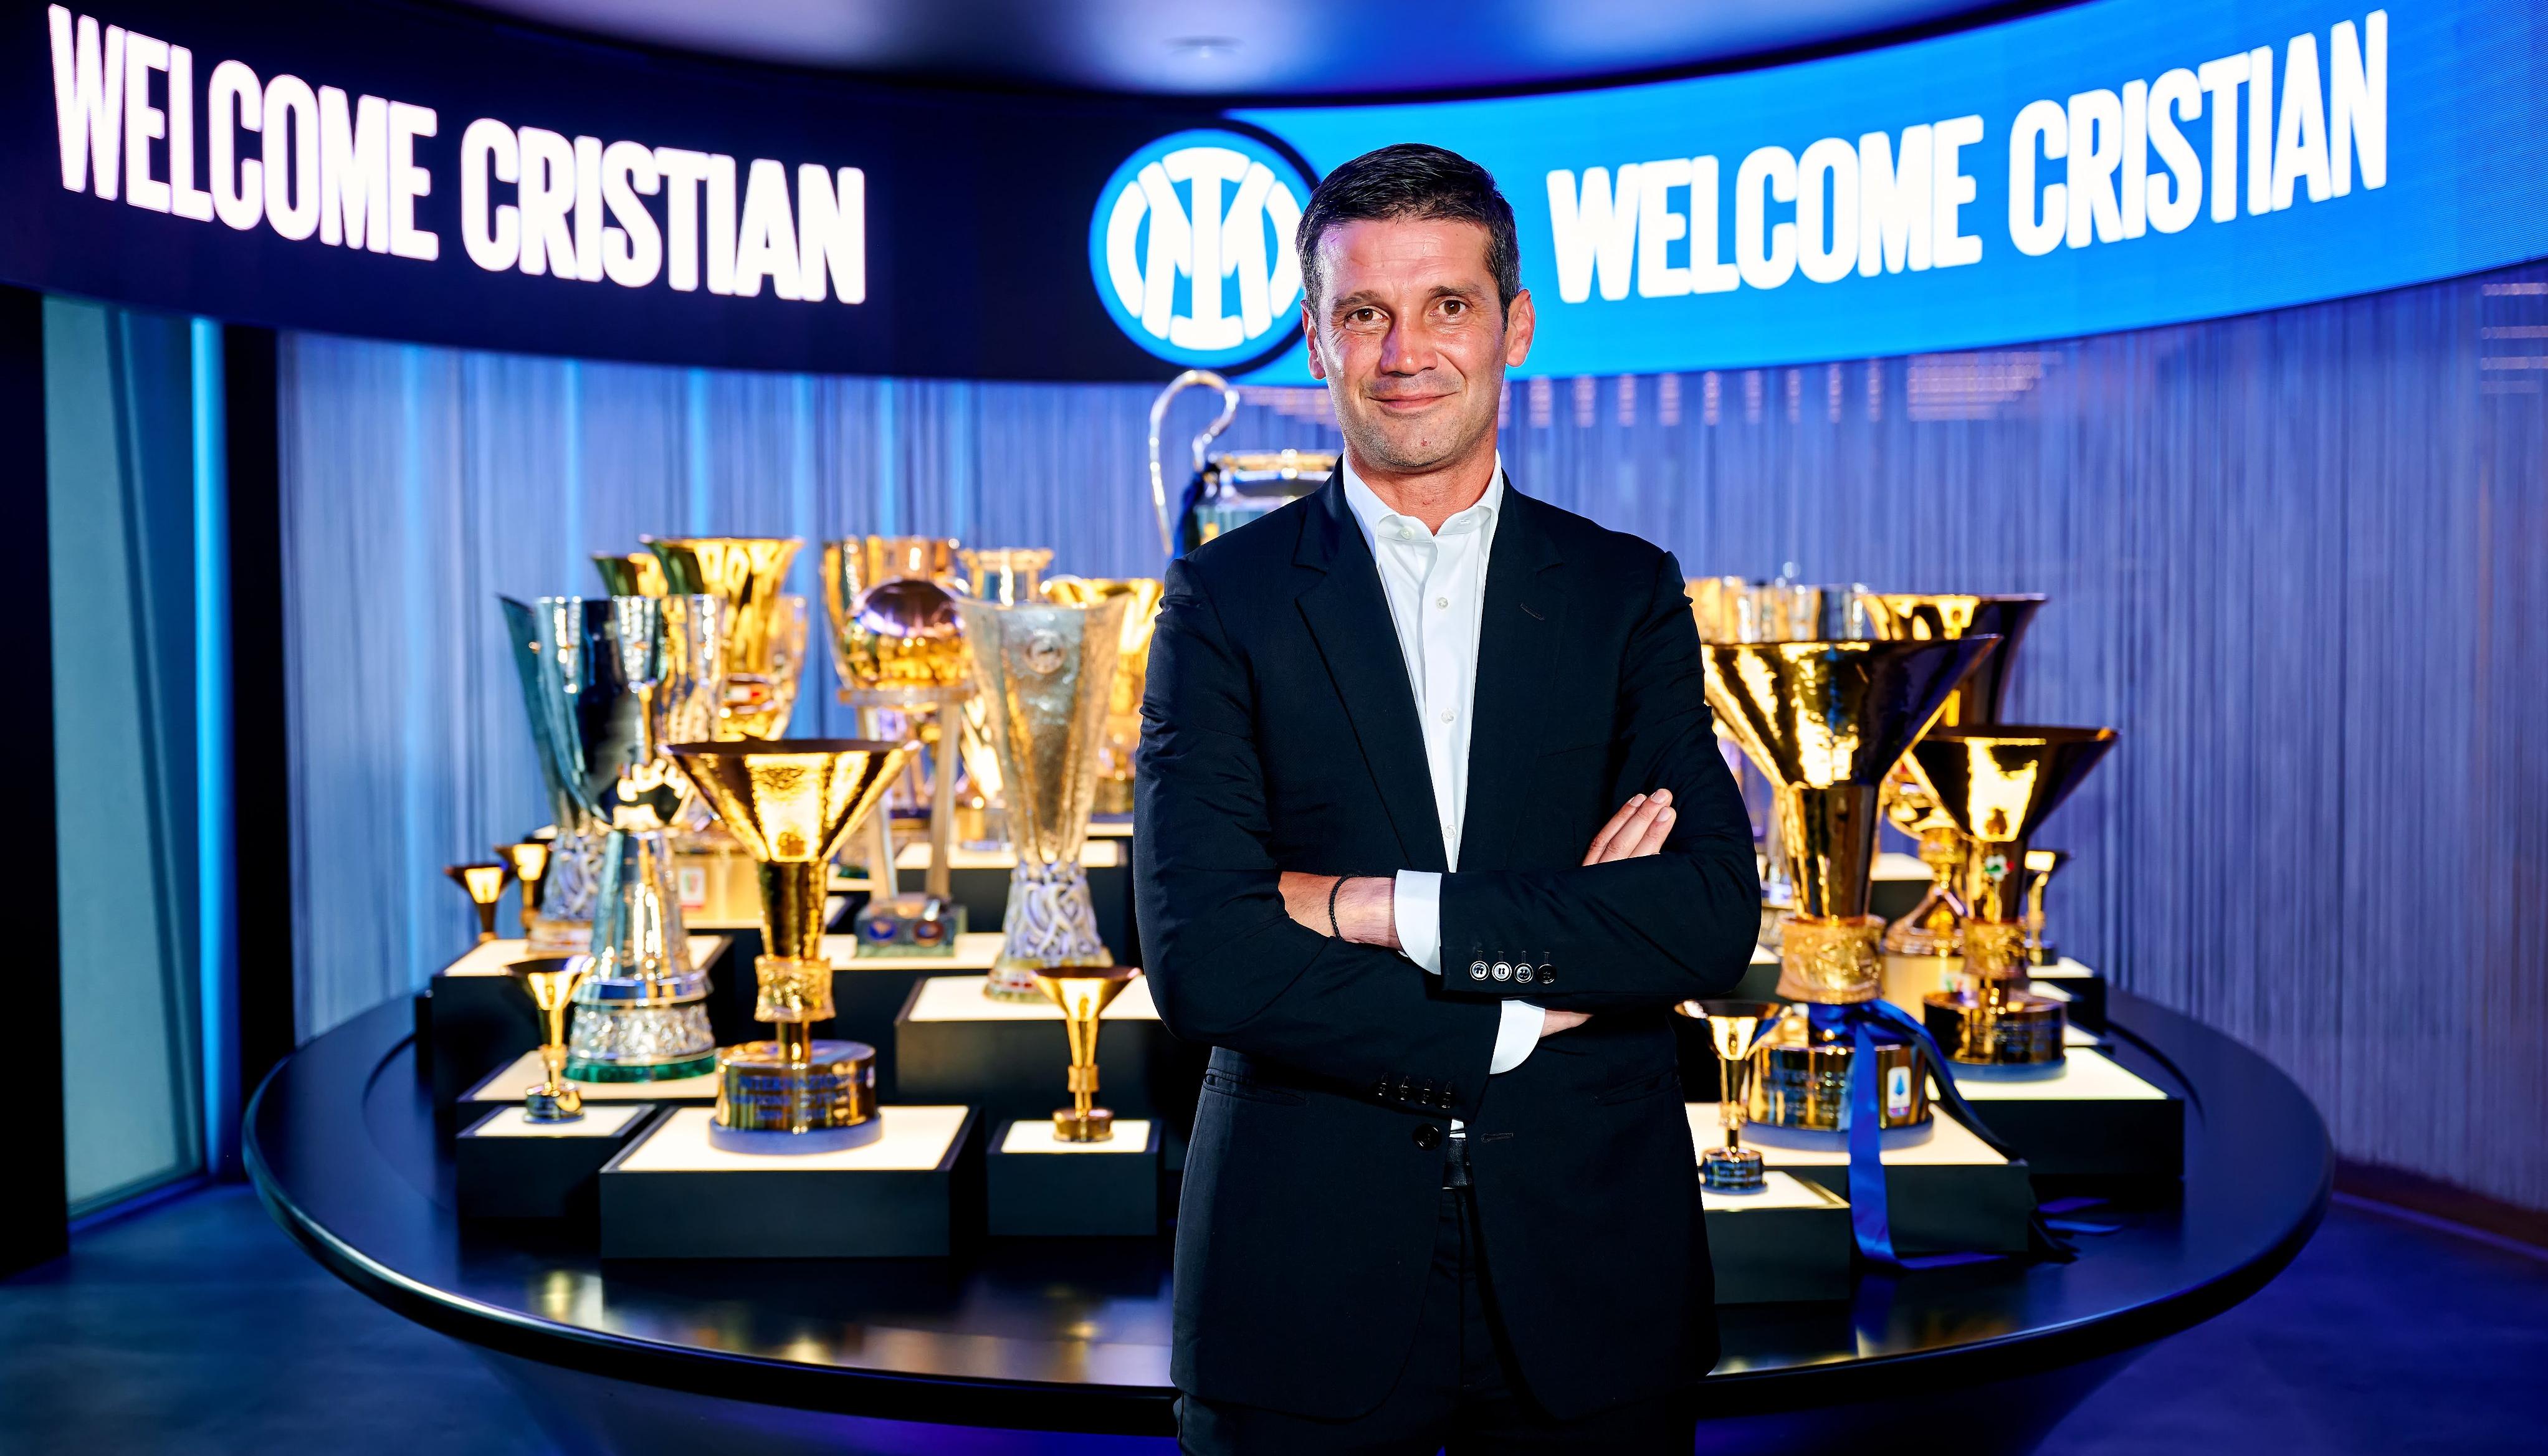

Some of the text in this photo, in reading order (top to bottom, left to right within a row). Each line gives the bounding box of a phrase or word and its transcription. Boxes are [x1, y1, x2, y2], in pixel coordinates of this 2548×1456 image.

[49, 3, 865, 303] WELCOME CRISTIAN
[1547, 9, 2387, 303] WELCOME CRISTIAN
